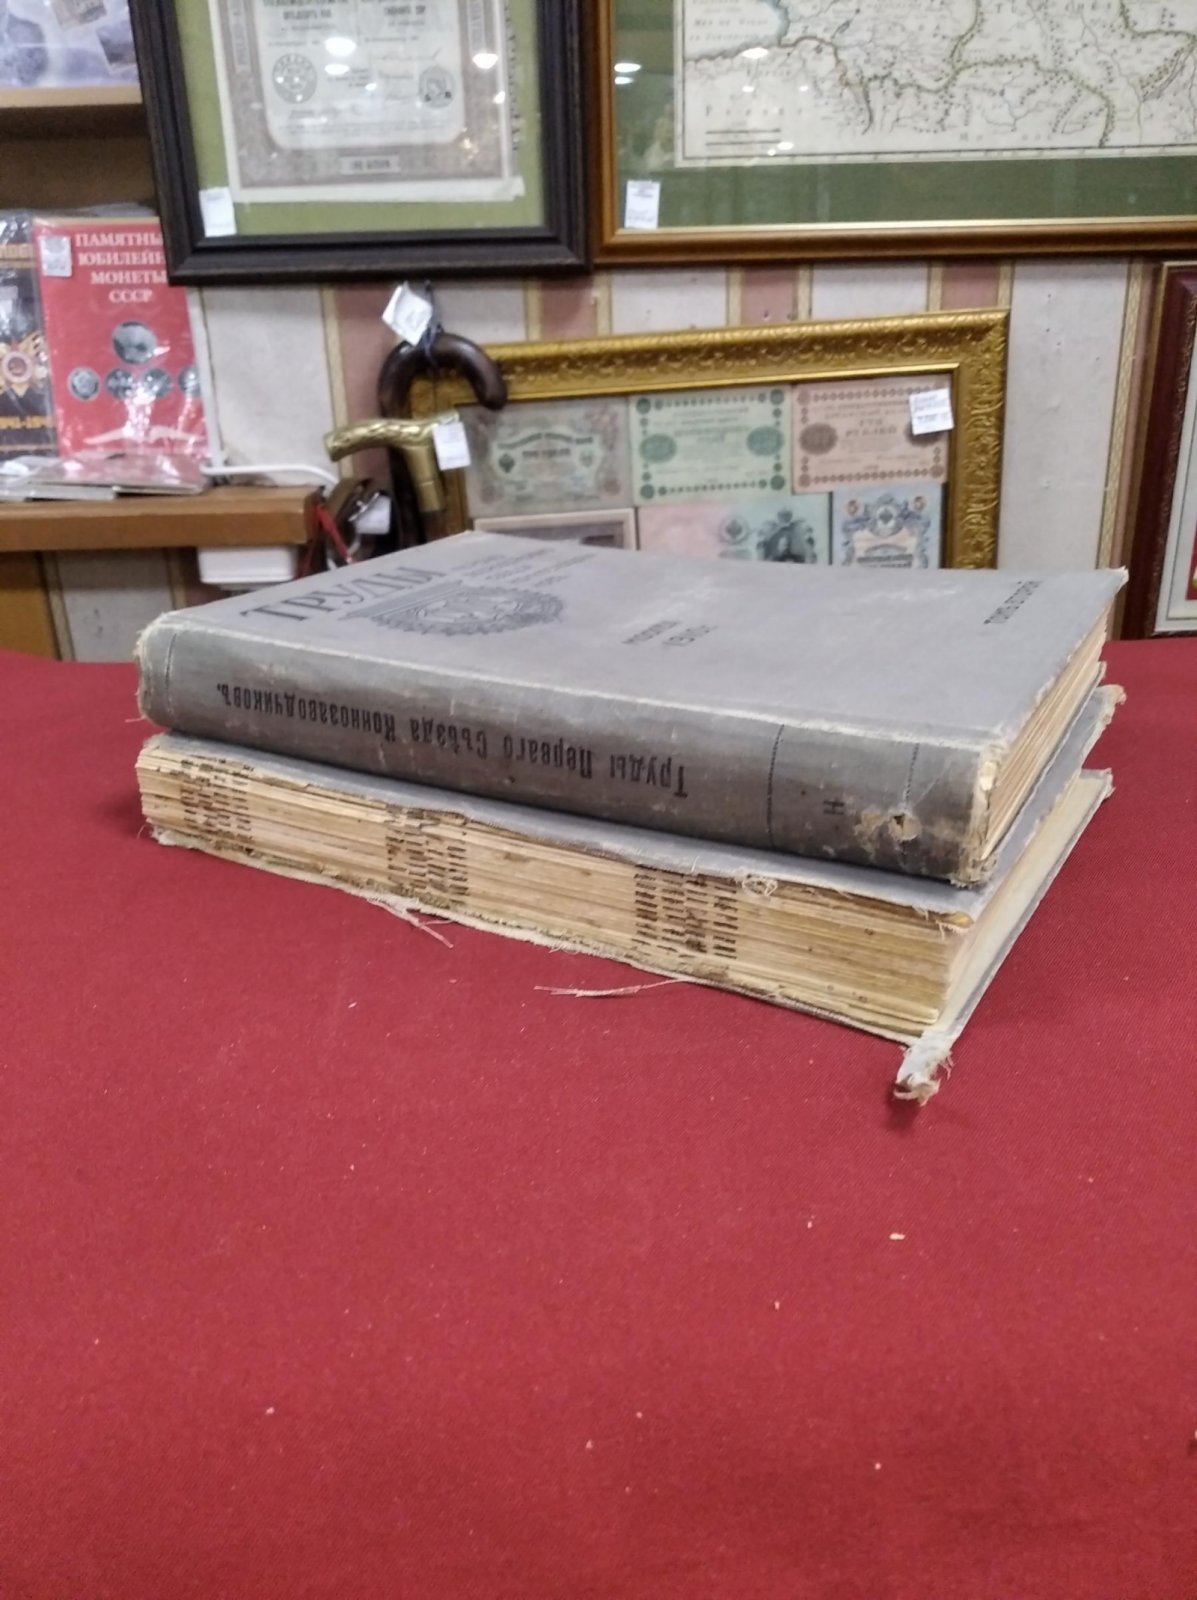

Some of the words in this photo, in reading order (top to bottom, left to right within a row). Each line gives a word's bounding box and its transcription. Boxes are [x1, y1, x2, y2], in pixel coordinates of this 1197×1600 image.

[91, 270, 168, 284] МОНЕТЫ
[108, 289, 153, 303] СССР
[609, 754, 688, 799] Труды
